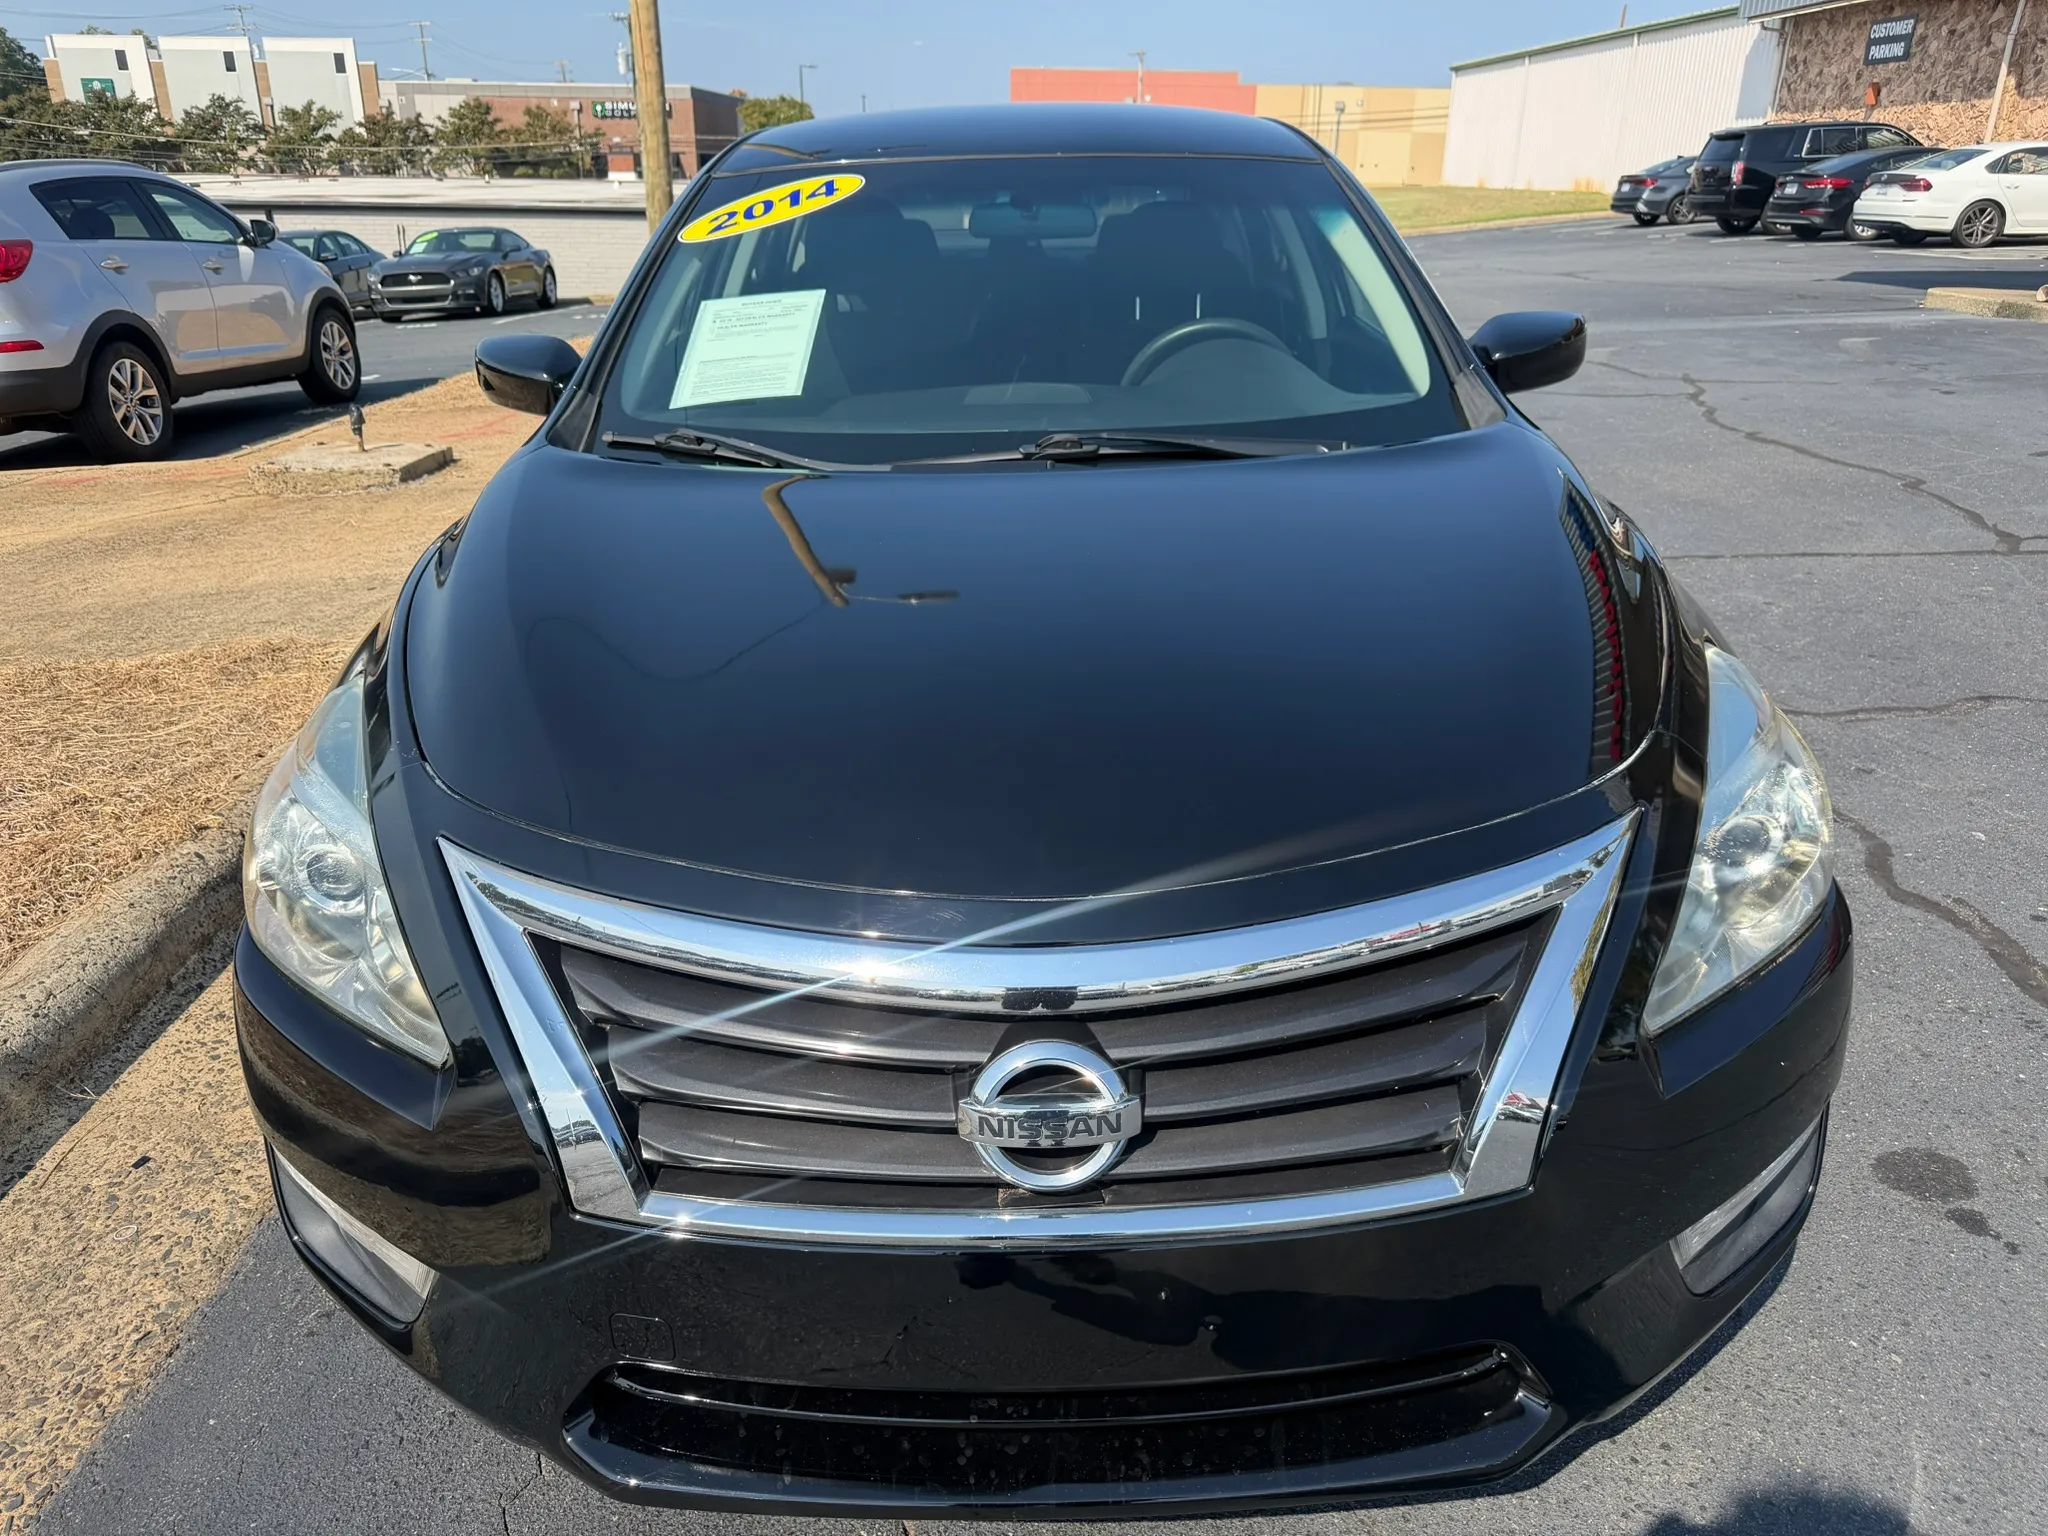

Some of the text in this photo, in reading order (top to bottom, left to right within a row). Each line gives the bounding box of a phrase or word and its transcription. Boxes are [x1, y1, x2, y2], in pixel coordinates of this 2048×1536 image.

[1870, 19, 1914, 39] CUSTOMER
[1868, 42, 1905, 60] PARKING
[706, 179, 840, 236] 2014
[977, 1112, 1122, 1141] NISSAN
